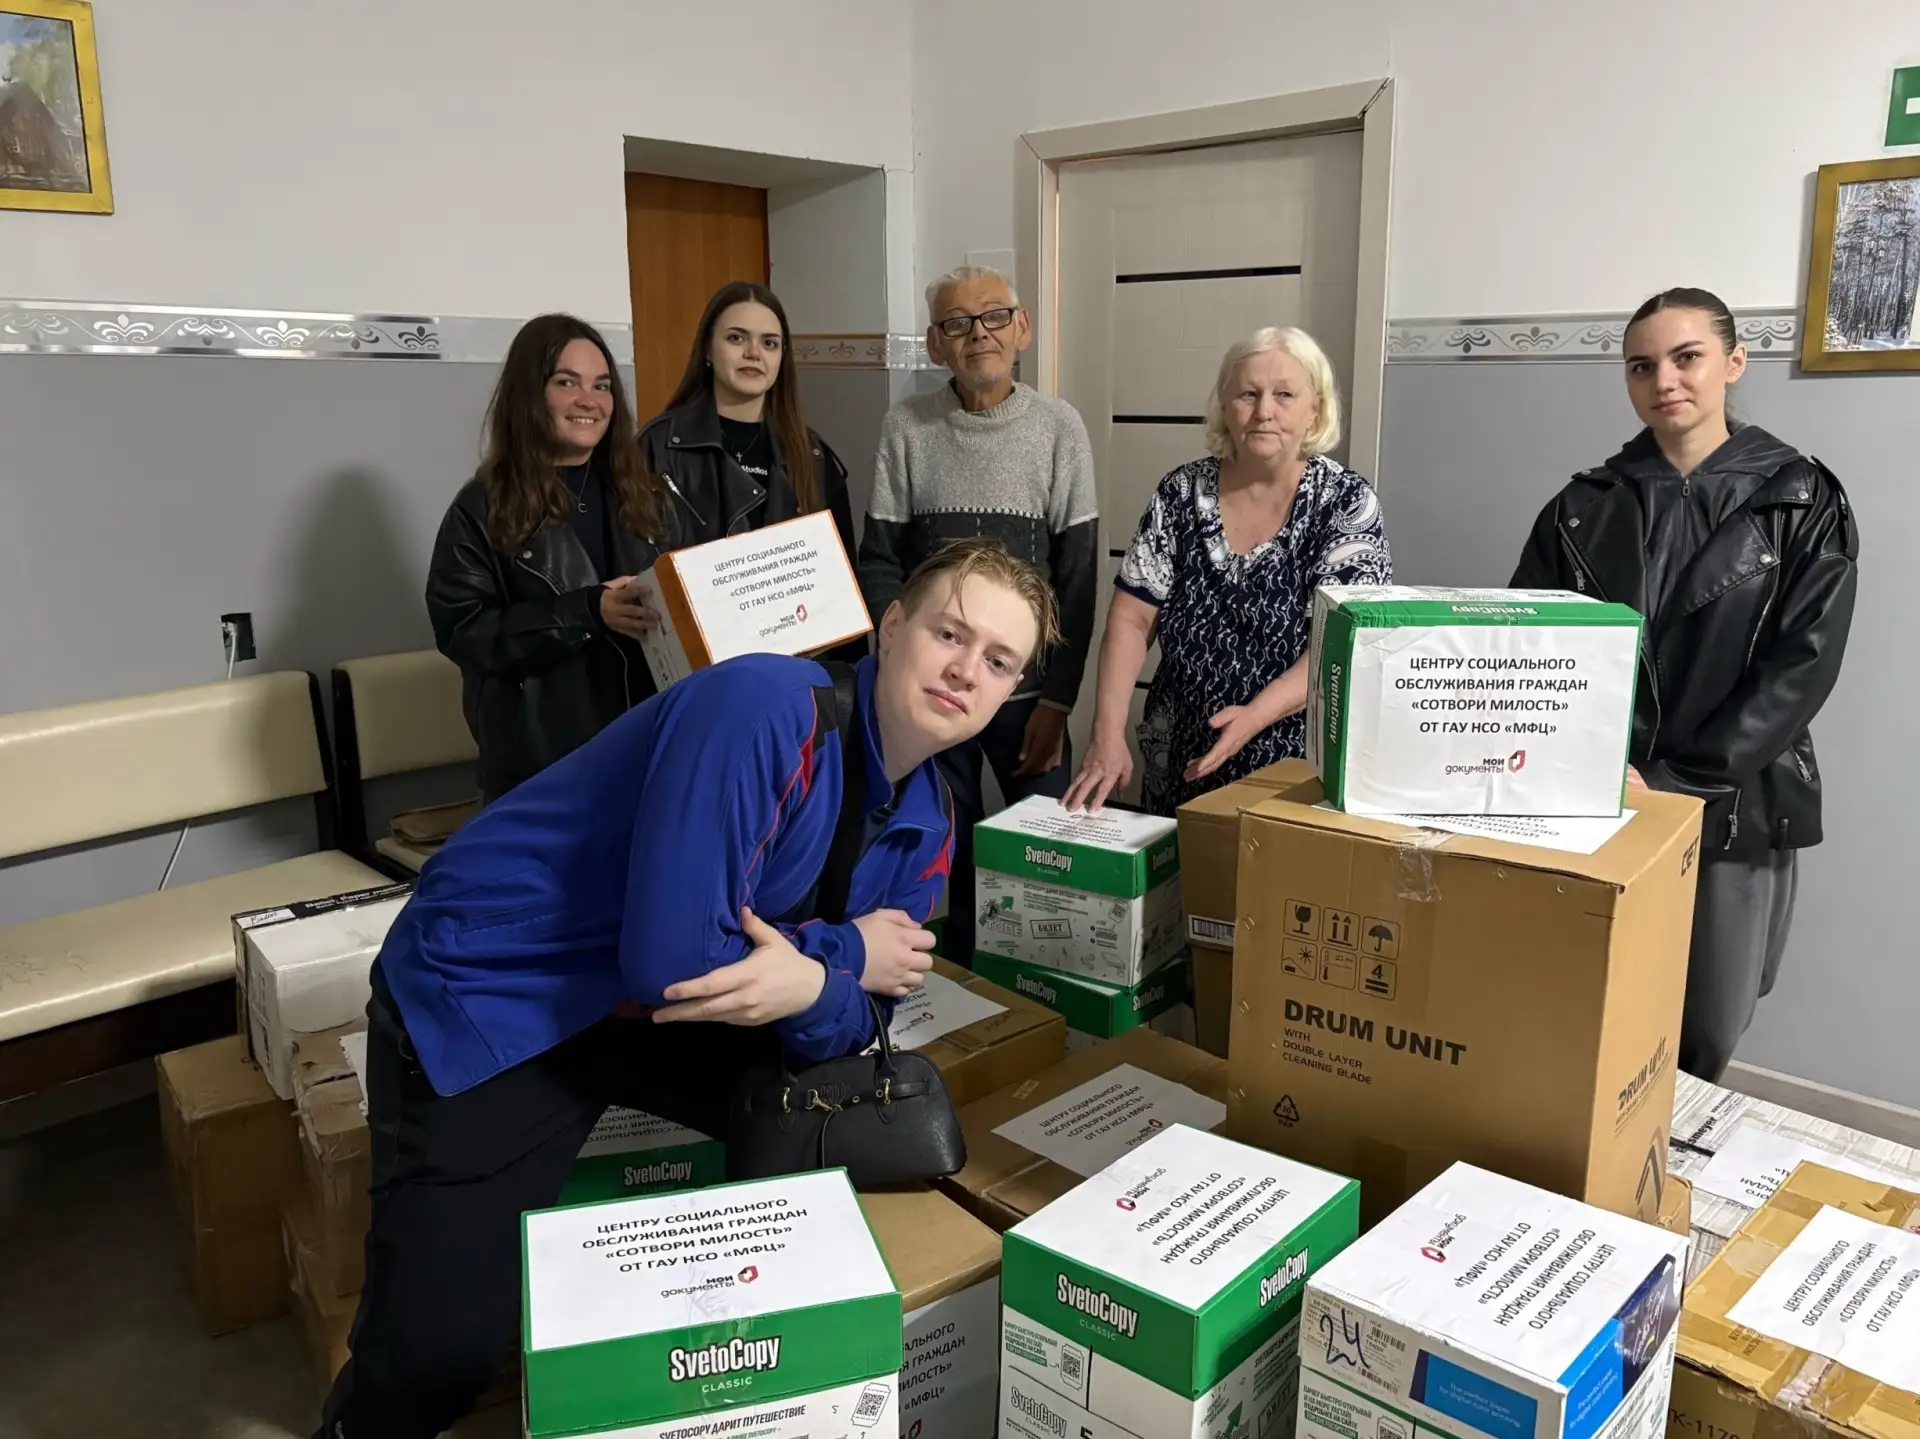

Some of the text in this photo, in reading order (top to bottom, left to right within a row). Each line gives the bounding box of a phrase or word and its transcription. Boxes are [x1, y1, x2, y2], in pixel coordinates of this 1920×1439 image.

[712, 550, 818, 587] ОБСЛУЖИВАНИЯ ГРАЖДАН
[714, 540, 806, 572] ЦЕНТРУ СОЦИАЛЬНОГО
[730, 567, 816, 597] «СОТВОРИ МИЛОСТЬ»
[739, 583, 815, 611] ОТ ГАУ НСО «МФЦ»
[1410, 657, 1576, 672] ЦЕНТРУ СОЦИАЛЬНОГО
[1395, 678, 1588, 693] ОБСЛУЖИВАНИЯ ГРАЖДАН
[1330, 663, 1341, 744] SvetoCopy
[1412, 699, 1569, 711] «СОТВОРИ МИЛОСТЬ»
[1420, 722, 1557, 736] ОТ ГАУ НСО «МФЦ»
[1445, 764, 1504, 775] документы
[1483, 758, 1504, 766] мои
[1025, 845, 1073, 873] SvetoCopy
[1371, 963, 1384, 980] 4
[1016, 973, 1057, 1004] SvetoCopy
[1284, 998, 1468, 1067] DRUM UNIT
[1284, 1027, 1311, 1043] WITH
[1282, 1051, 1372, 1085] CLEANING BLADE
[1283, 1039, 1363, 1070] DOUBLE LAYER
[1039, 1083, 1123, 1128] ЦЕНТРУ СОЦИАЛЬНОГО
[1044, 1085, 1142, 1137] ОБСЛУЖИВАНИЯ ГРАЖДАН
[1067, 1115, 1106, 1138] «СОТВОРИ
[1084, 1131, 1097, 1141] ОТ
[1096, 1124, 1111, 1136] ГАУ
[1110, 1116, 1128, 1128] НСО
[624, 1160, 692, 1186] SvetoCopy
[597, 1198, 788, 1235] ЦЕНТРУ СОЦИАЛЬНОГО
[1136, 1172, 1222, 1233] ОТ ГАУ НСО «МФЦ»
[1152, 1176, 1247, 1246] «СОТВОРИ МИЛОСТЬ»
[582, 1208, 808, 1249] ОБСЛУЖИВАНИЯ ГРАЖДАН
[1159, 1176, 1277, 1265] ОБСЛУЖИВАНИЯ ГРАЖДАН
[1190, 1188, 1291, 1266] ЦЕНТРУ СОЦИАЛЬНОГО
[605, 1225, 792, 1259] «СОТВОРИ МИЛОСТЬ»
[619, 1241, 786, 1273] ОТ ГАУ НСО «МФЦ»
[1454, 1222, 1532, 1288] ОТ ГАУ НСО «МФЦ»
[705, 1274, 734, 1284] мои
[1259, 1247, 1309, 1307] SvetoCopy
[1477, 1228, 1561, 1305] «СОТВОРИ МИЛОСТЬ»
[1493, 1228, 1597, 1327] ОБСЛУЖИВАНИЯ ГРАЖДАН
[1782, 1239, 1850, 1313] ЦЕНТРУ СОЦИАЛЬНОГО
[660, 1280, 735, 1298] документы
[1528, 1243, 1617, 1330] ЦЕНТРУ СОЦИАЛЬНОГО
[1801, 1241, 1877, 1327] ОБСЛУЖИВАНИЯ ГРАЖДАН
[1839, 1255, 1898, 1324] «СОТВОРИ МИЛОСТЬ»
[1884, 1290, 1903, 1309] НСО
[1057, 1273, 1138, 1338] SvetoCopy
[1873, 1305, 1892, 1322] ГАУ
[1079, 1318, 1118, 1341] CLASSIC
[1866, 1319, 1883, 1332] ОТ
[670, 1336, 780, 1381] SvetoCopy
[912, 1336, 966, 1368] ГРАЖДАН
[702, 1376, 753, 1393] CLASSIC
[904, 1386, 945, 1410] «МФЦ»
[659, 1404, 807, 1439] SVETOCOPY ДАРИТ ПУТЕШЕСТВИЕ
[1010, 1386, 1067, 1439] SvetoCopy
